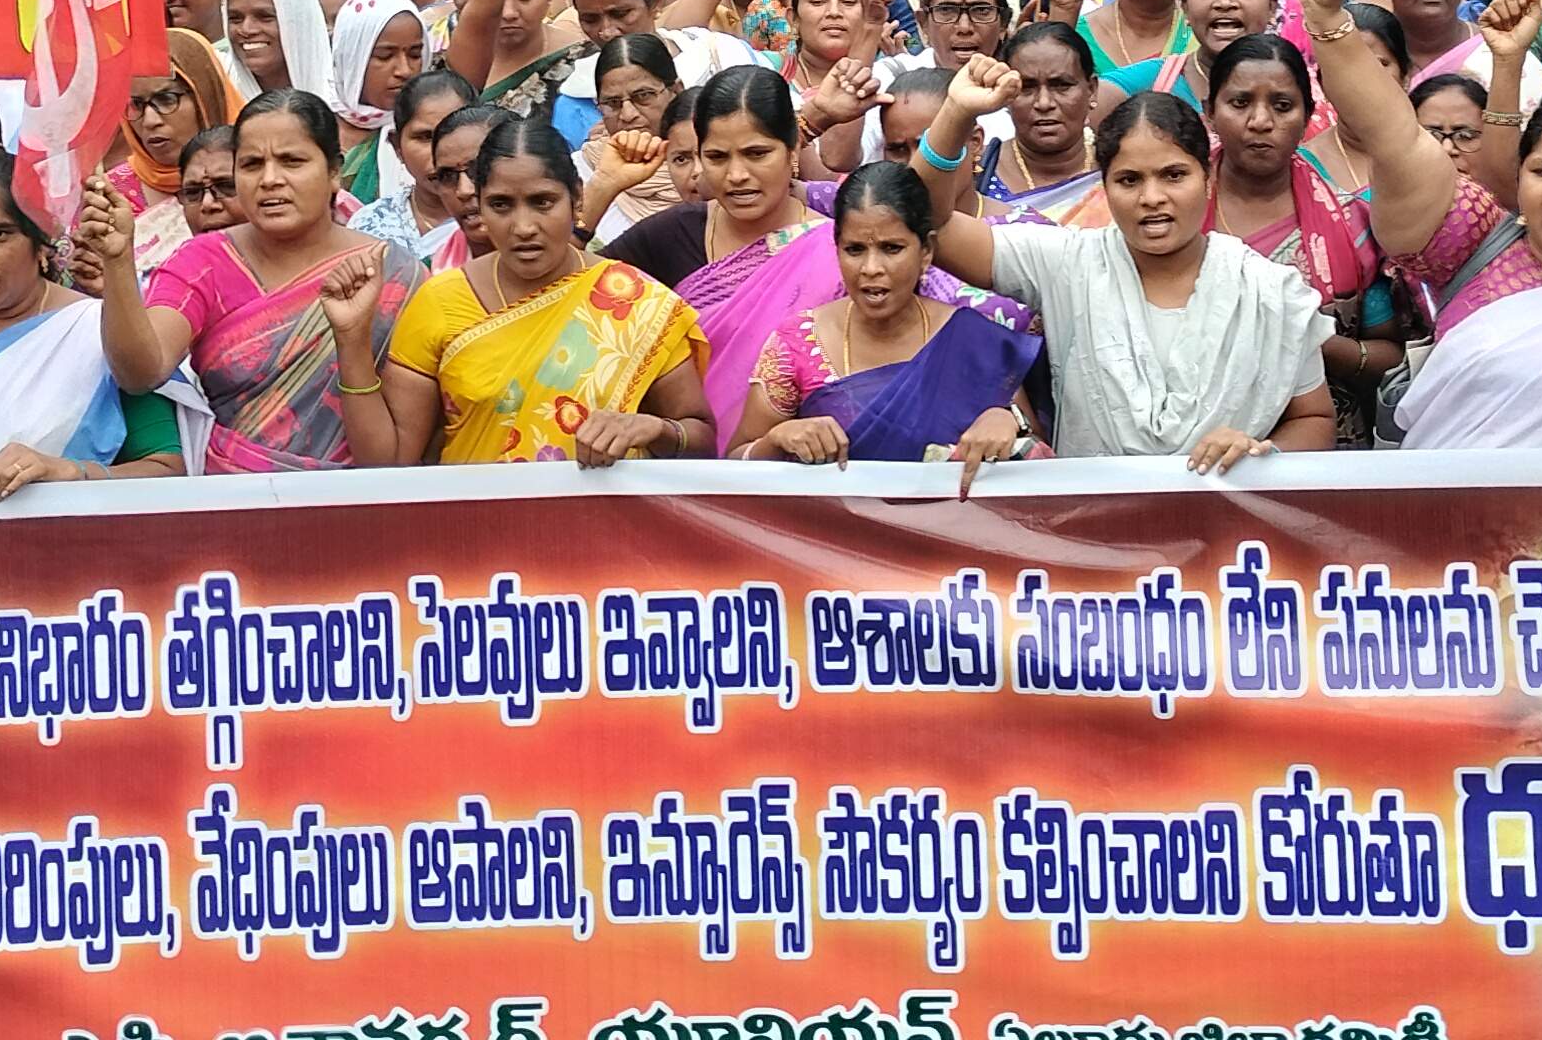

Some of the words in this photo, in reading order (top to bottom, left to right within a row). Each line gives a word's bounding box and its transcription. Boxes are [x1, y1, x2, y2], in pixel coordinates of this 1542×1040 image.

[166, 576, 407, 766] తగ్గించాలని,
[415, 578, 581, 720] సెలవులు
[603, 586, 794, 728] ఇవ్వాలని,
[812, 573, 996, 689] ఆశాలకు
[1017, 573, 1204, 713] సంబంధం
[1226, 547, 1301, 692] లేని
[1320, 568, 1497, 691] పనులను
[194, 789, 390, 958] వేధింపులు
[409, 801, 588, 936] ఆపాలని,
[823, 790, 980, 967] సౌకర్యం
[1000, 791, 1241, 955] కల్పించాలని
[1261, 769, 1441, 918] కోరుతూ
